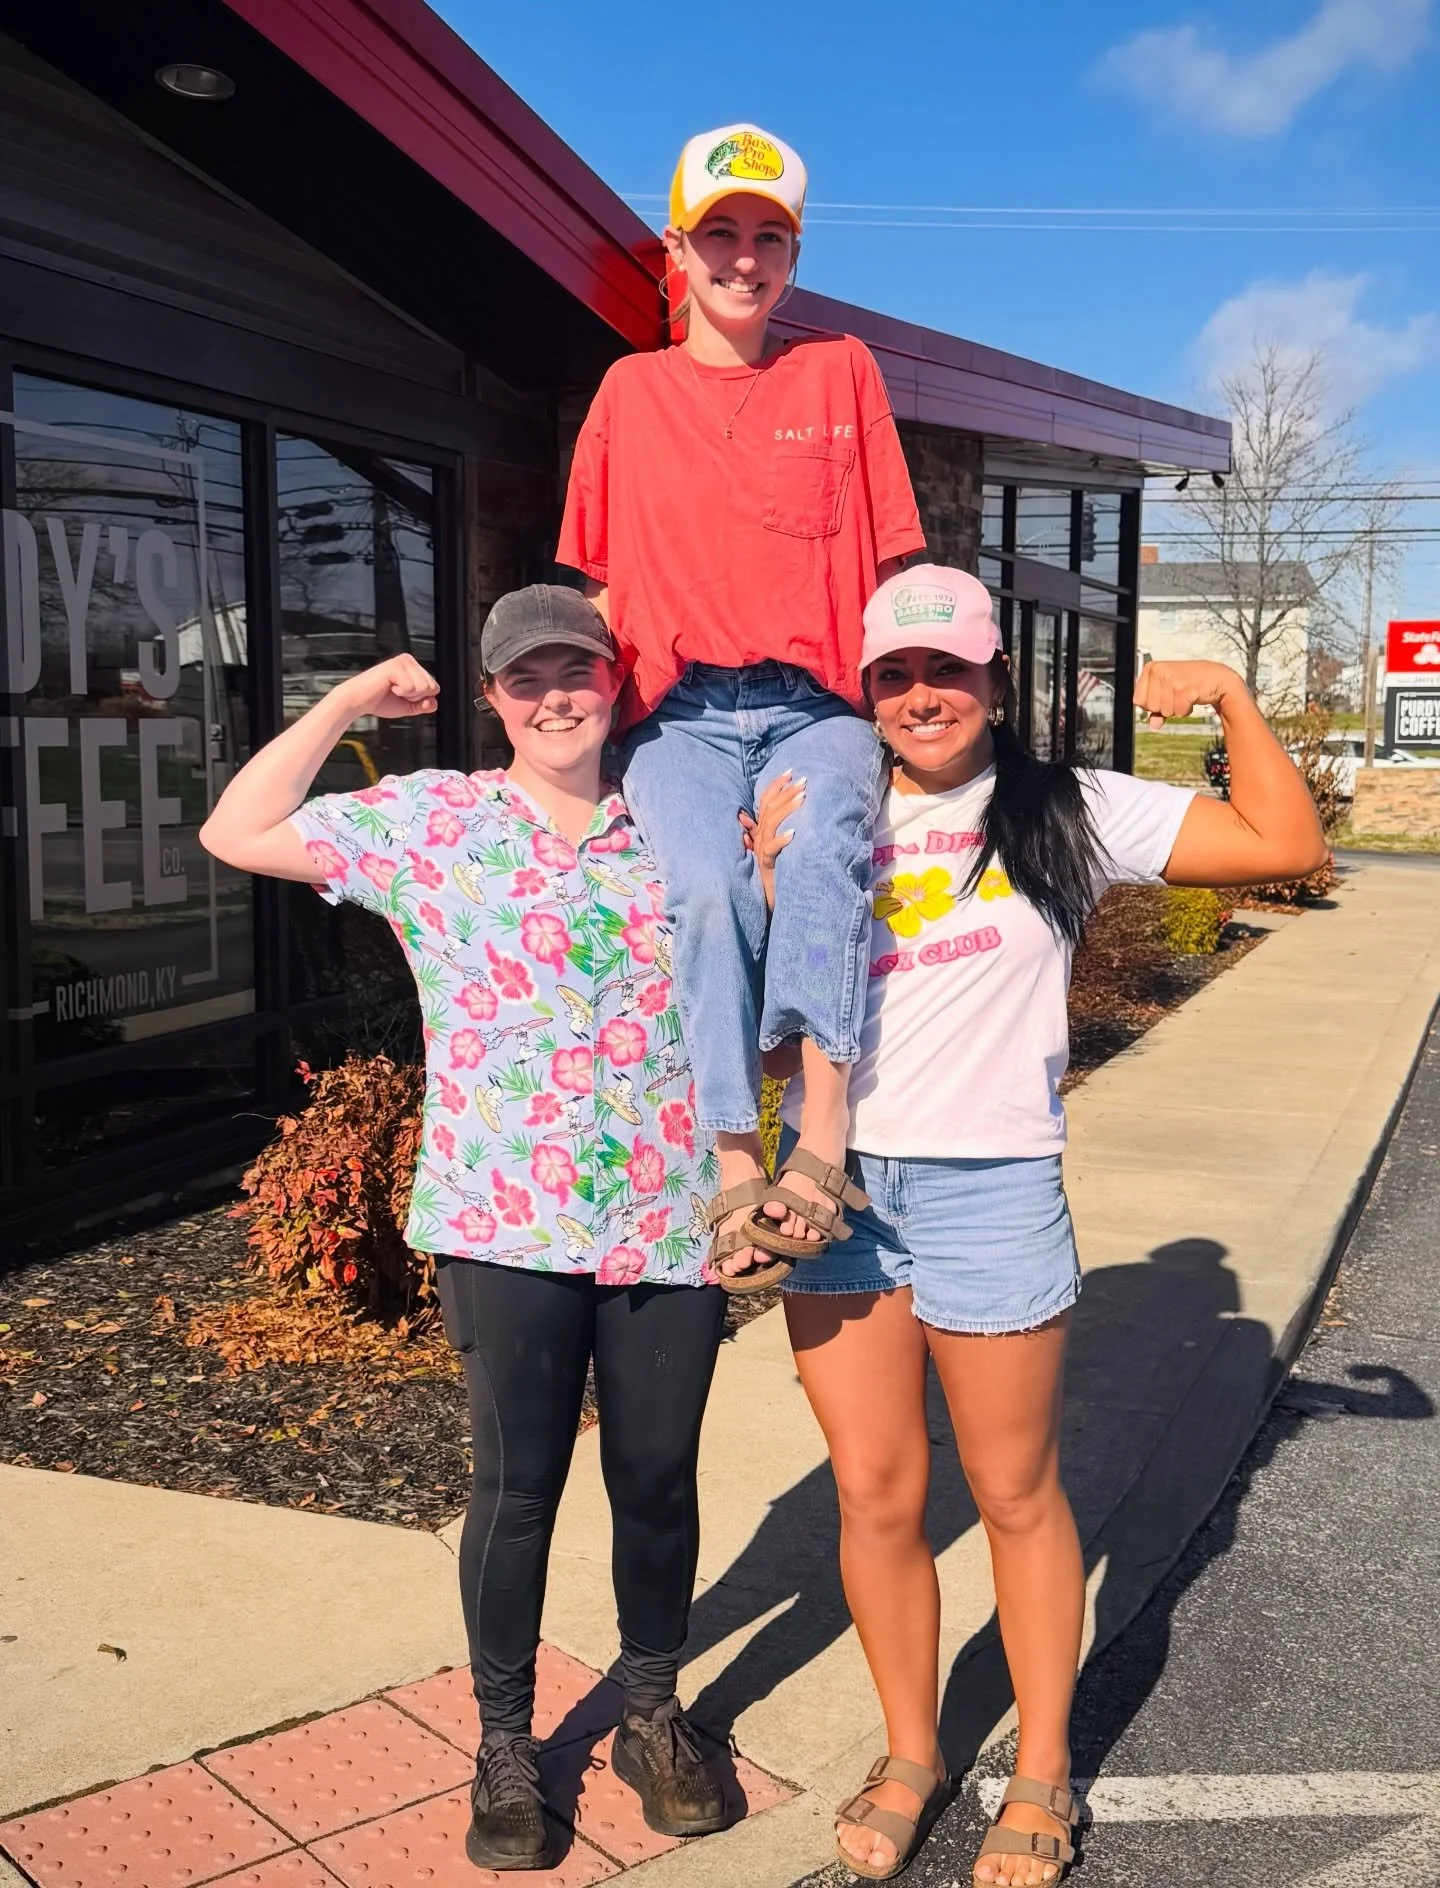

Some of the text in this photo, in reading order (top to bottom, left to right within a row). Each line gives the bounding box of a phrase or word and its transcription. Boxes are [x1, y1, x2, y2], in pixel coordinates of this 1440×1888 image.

[742, 134, 773, 152] Bass
[743, 146, 765, 161] Pro
[741, 158, 778, 177] Shops
[774, 424, 855, 441] SALT LFE
[896, 605, 926, 618] BASS
[162, 847, 185, 874] CO.
[919, 926, 1002, 966] CLUB
